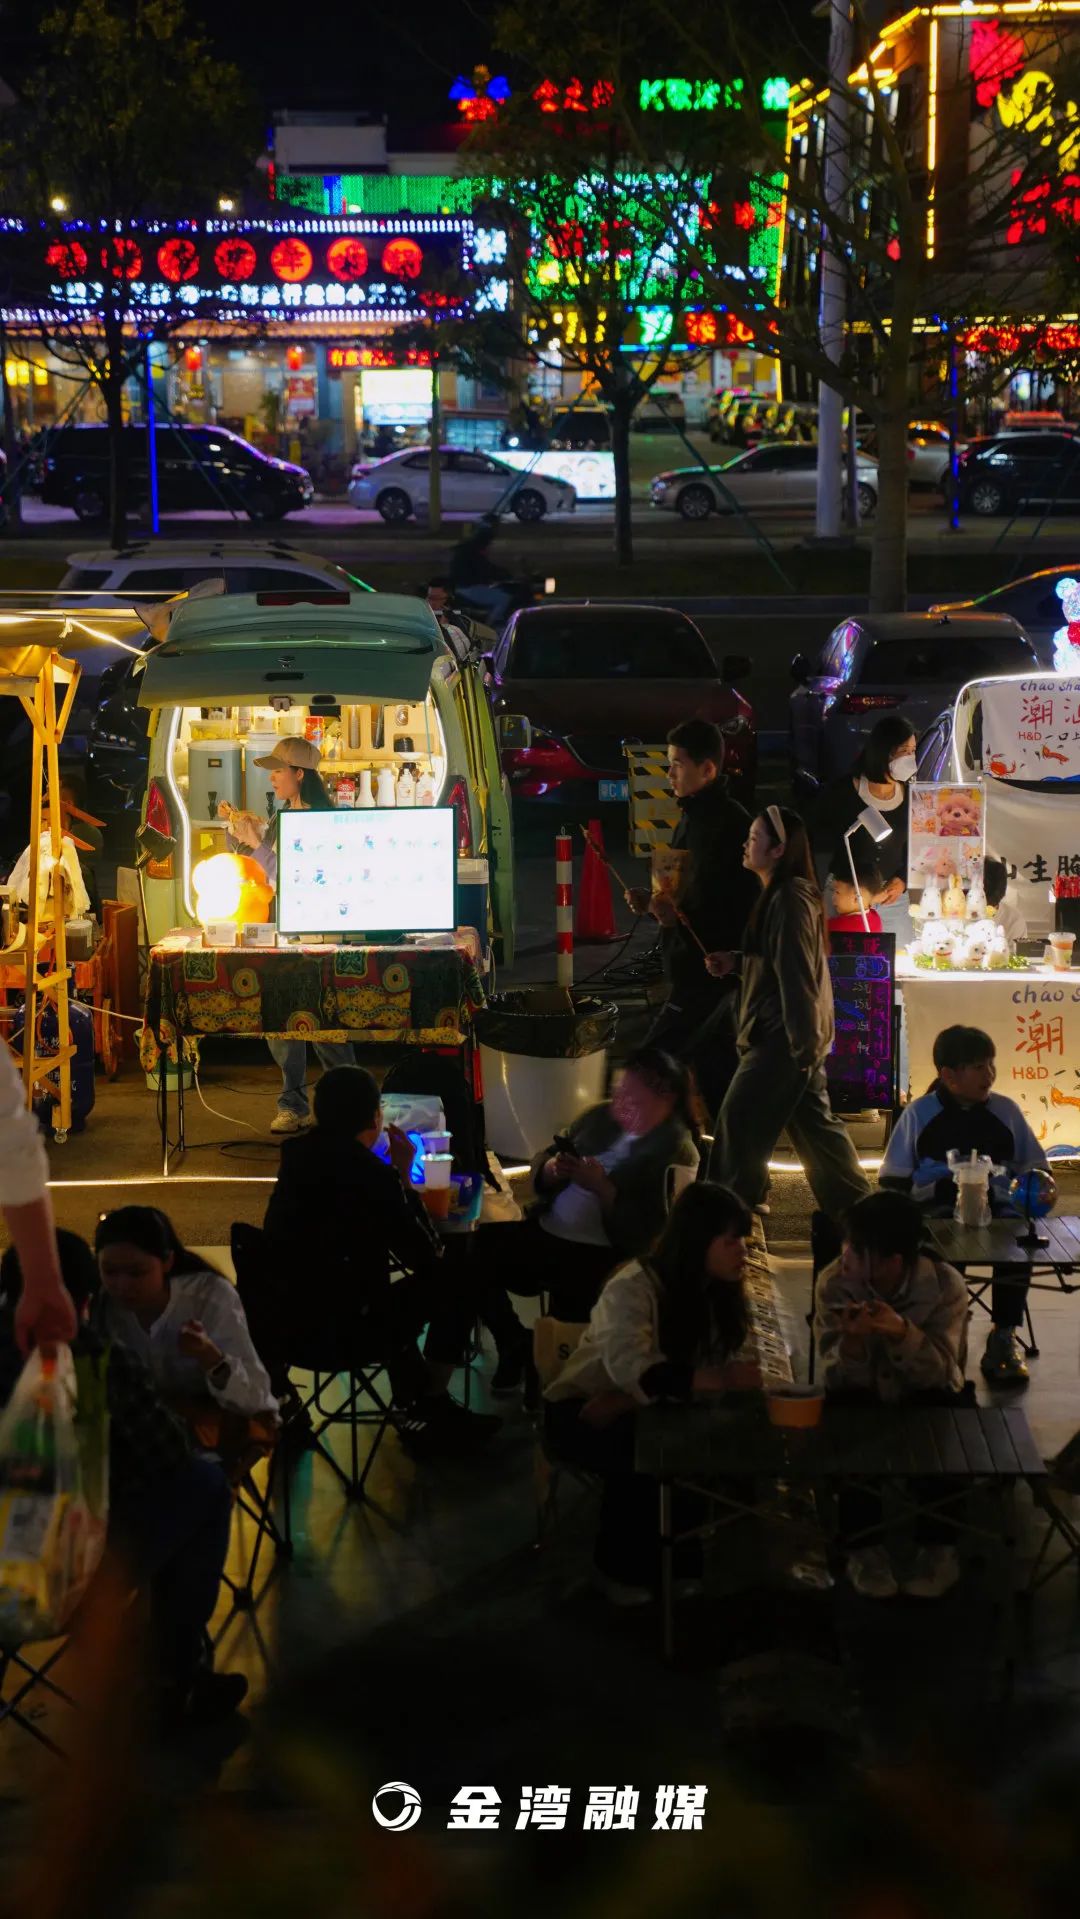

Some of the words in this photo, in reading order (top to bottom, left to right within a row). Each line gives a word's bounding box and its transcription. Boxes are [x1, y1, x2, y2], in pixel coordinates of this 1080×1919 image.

[1018, 732, 1043, 742] H&D
[1015, 1009, 1064, 1064] 潮
[1012, 1066, 1049, 1080] H&D
